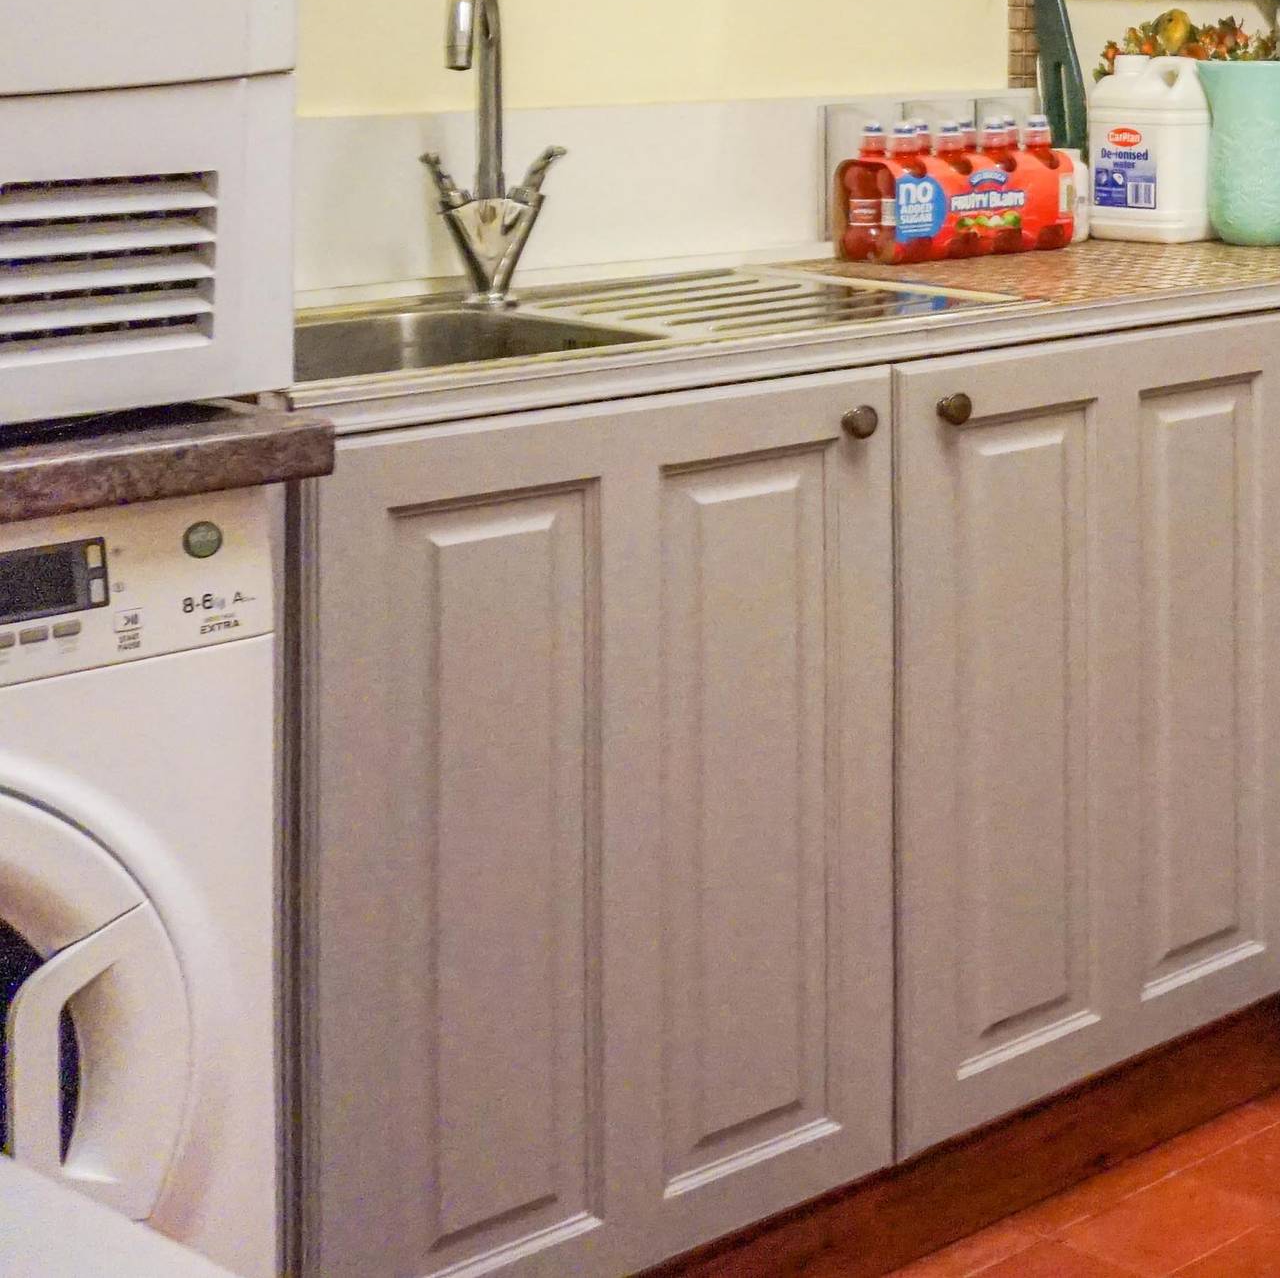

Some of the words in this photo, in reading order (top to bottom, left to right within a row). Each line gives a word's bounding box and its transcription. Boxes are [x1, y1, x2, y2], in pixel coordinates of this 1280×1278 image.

[1100, 147, 1149, 161] De-ionised
[899, 181, 933, 205] no
[901, 212, 932, 223] SUGAR
[200, 619, 241, 634] EXTRA
